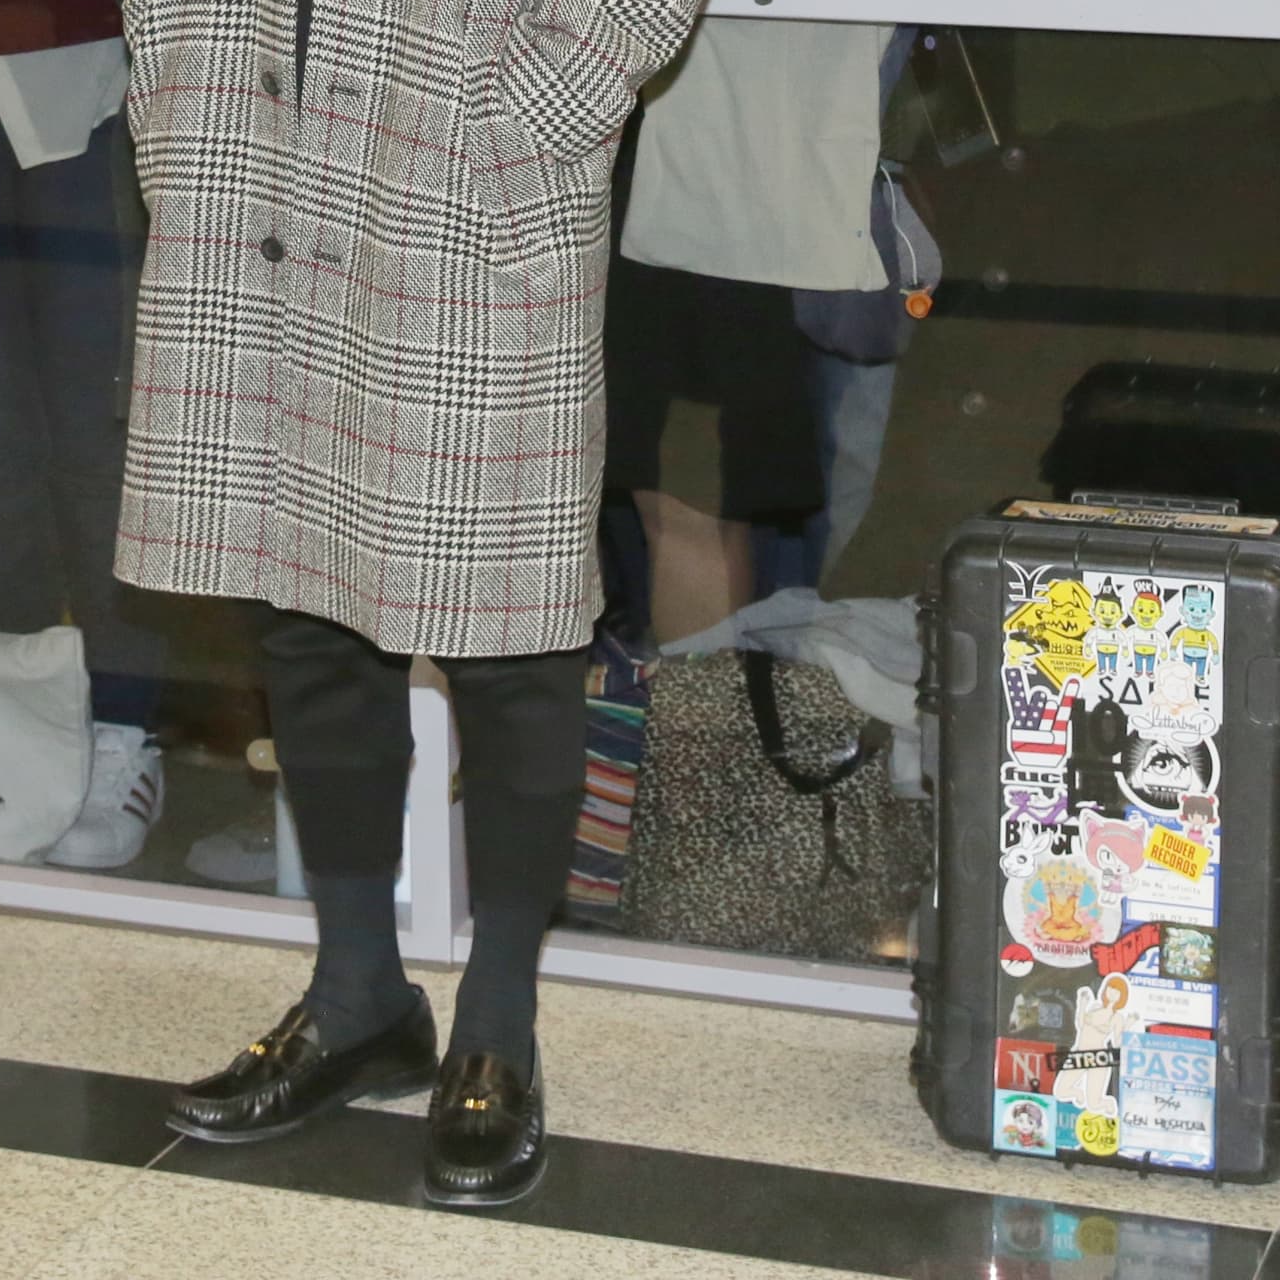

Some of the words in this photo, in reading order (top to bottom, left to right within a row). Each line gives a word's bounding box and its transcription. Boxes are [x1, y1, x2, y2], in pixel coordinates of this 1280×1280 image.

[1005, 766, 1071, 784] fuc
[1150, 843, 1199, 879] RECORDS
[1160, 831, 1197, 861] TOWER
[1126, 1049, 1210, 1084] PASS
